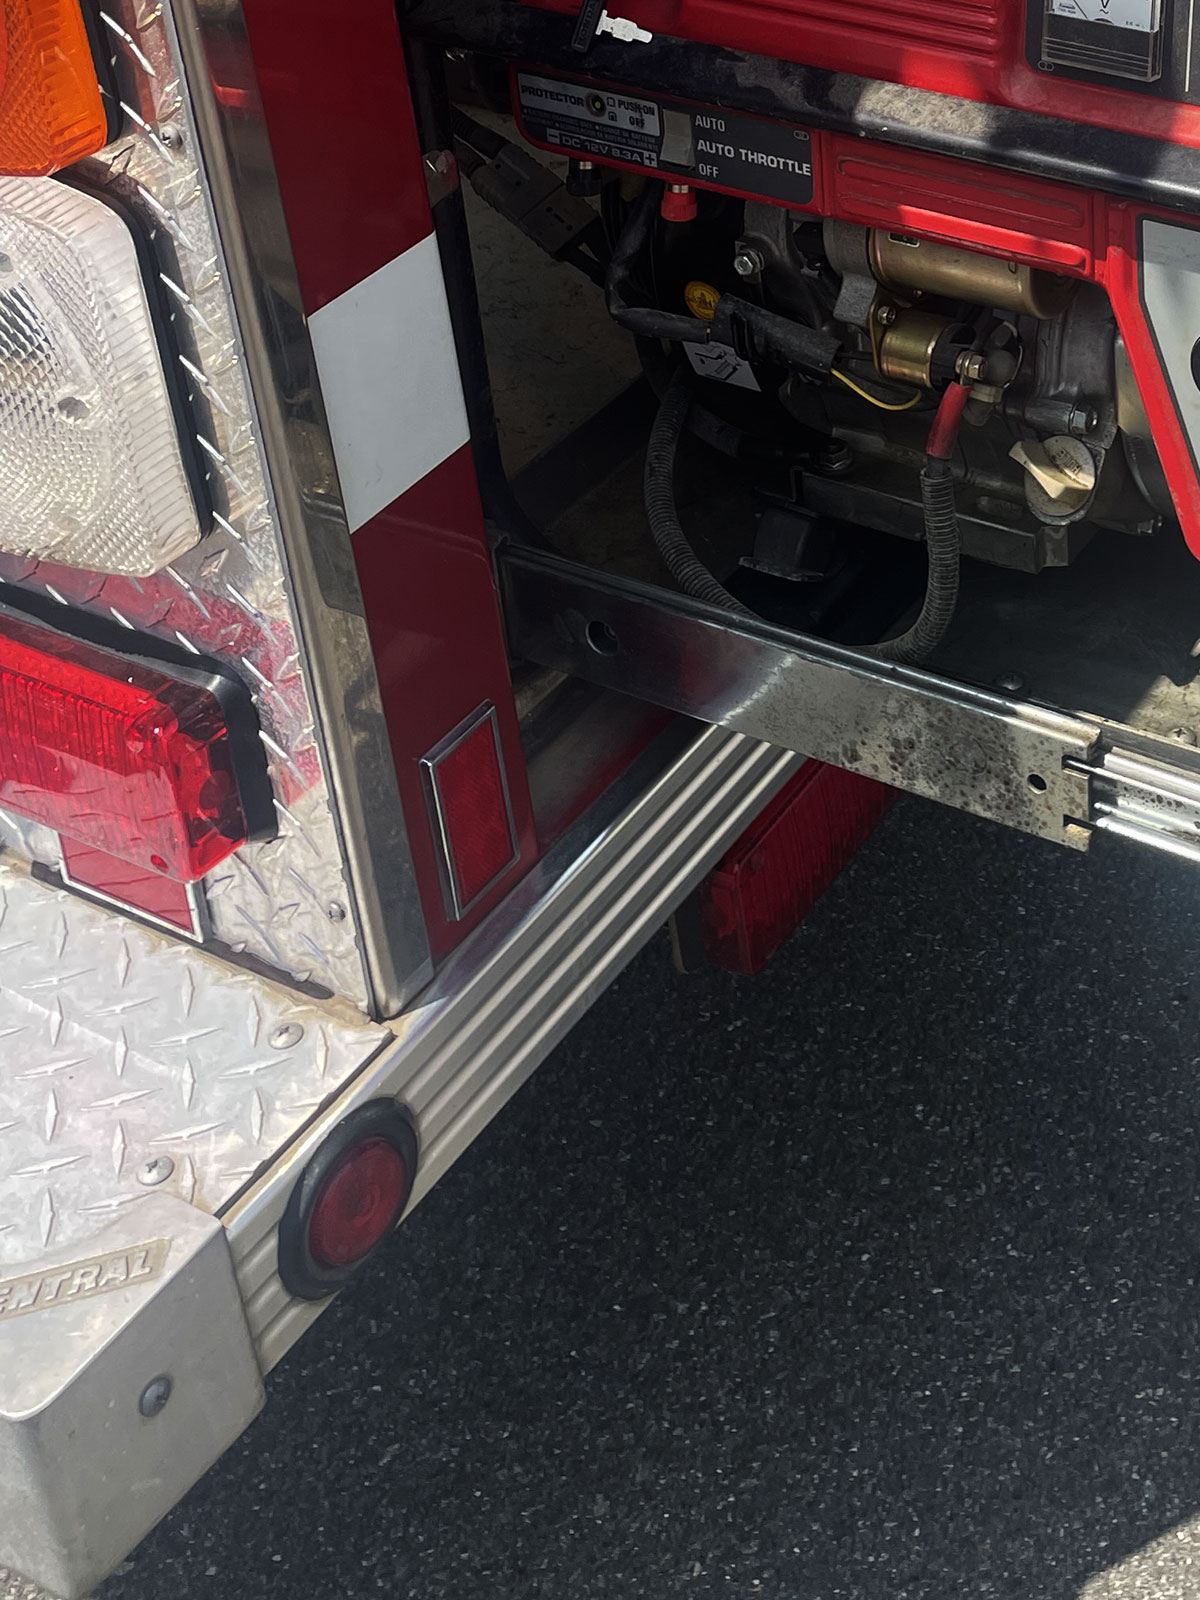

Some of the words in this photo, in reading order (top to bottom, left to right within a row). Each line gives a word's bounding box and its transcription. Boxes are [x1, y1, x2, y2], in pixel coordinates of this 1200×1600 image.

[520, 84, 585, 107] PROTECTOR
[695, 115, 725, 132] AUTO
[562, 136, 581, 148] DC
[584, 142, 608, 154] 12V
[697, 139, 735, 158] AUTO
[739, 148, 811, 176] THROTTLE
[698, 163, 719, 178] OFF
